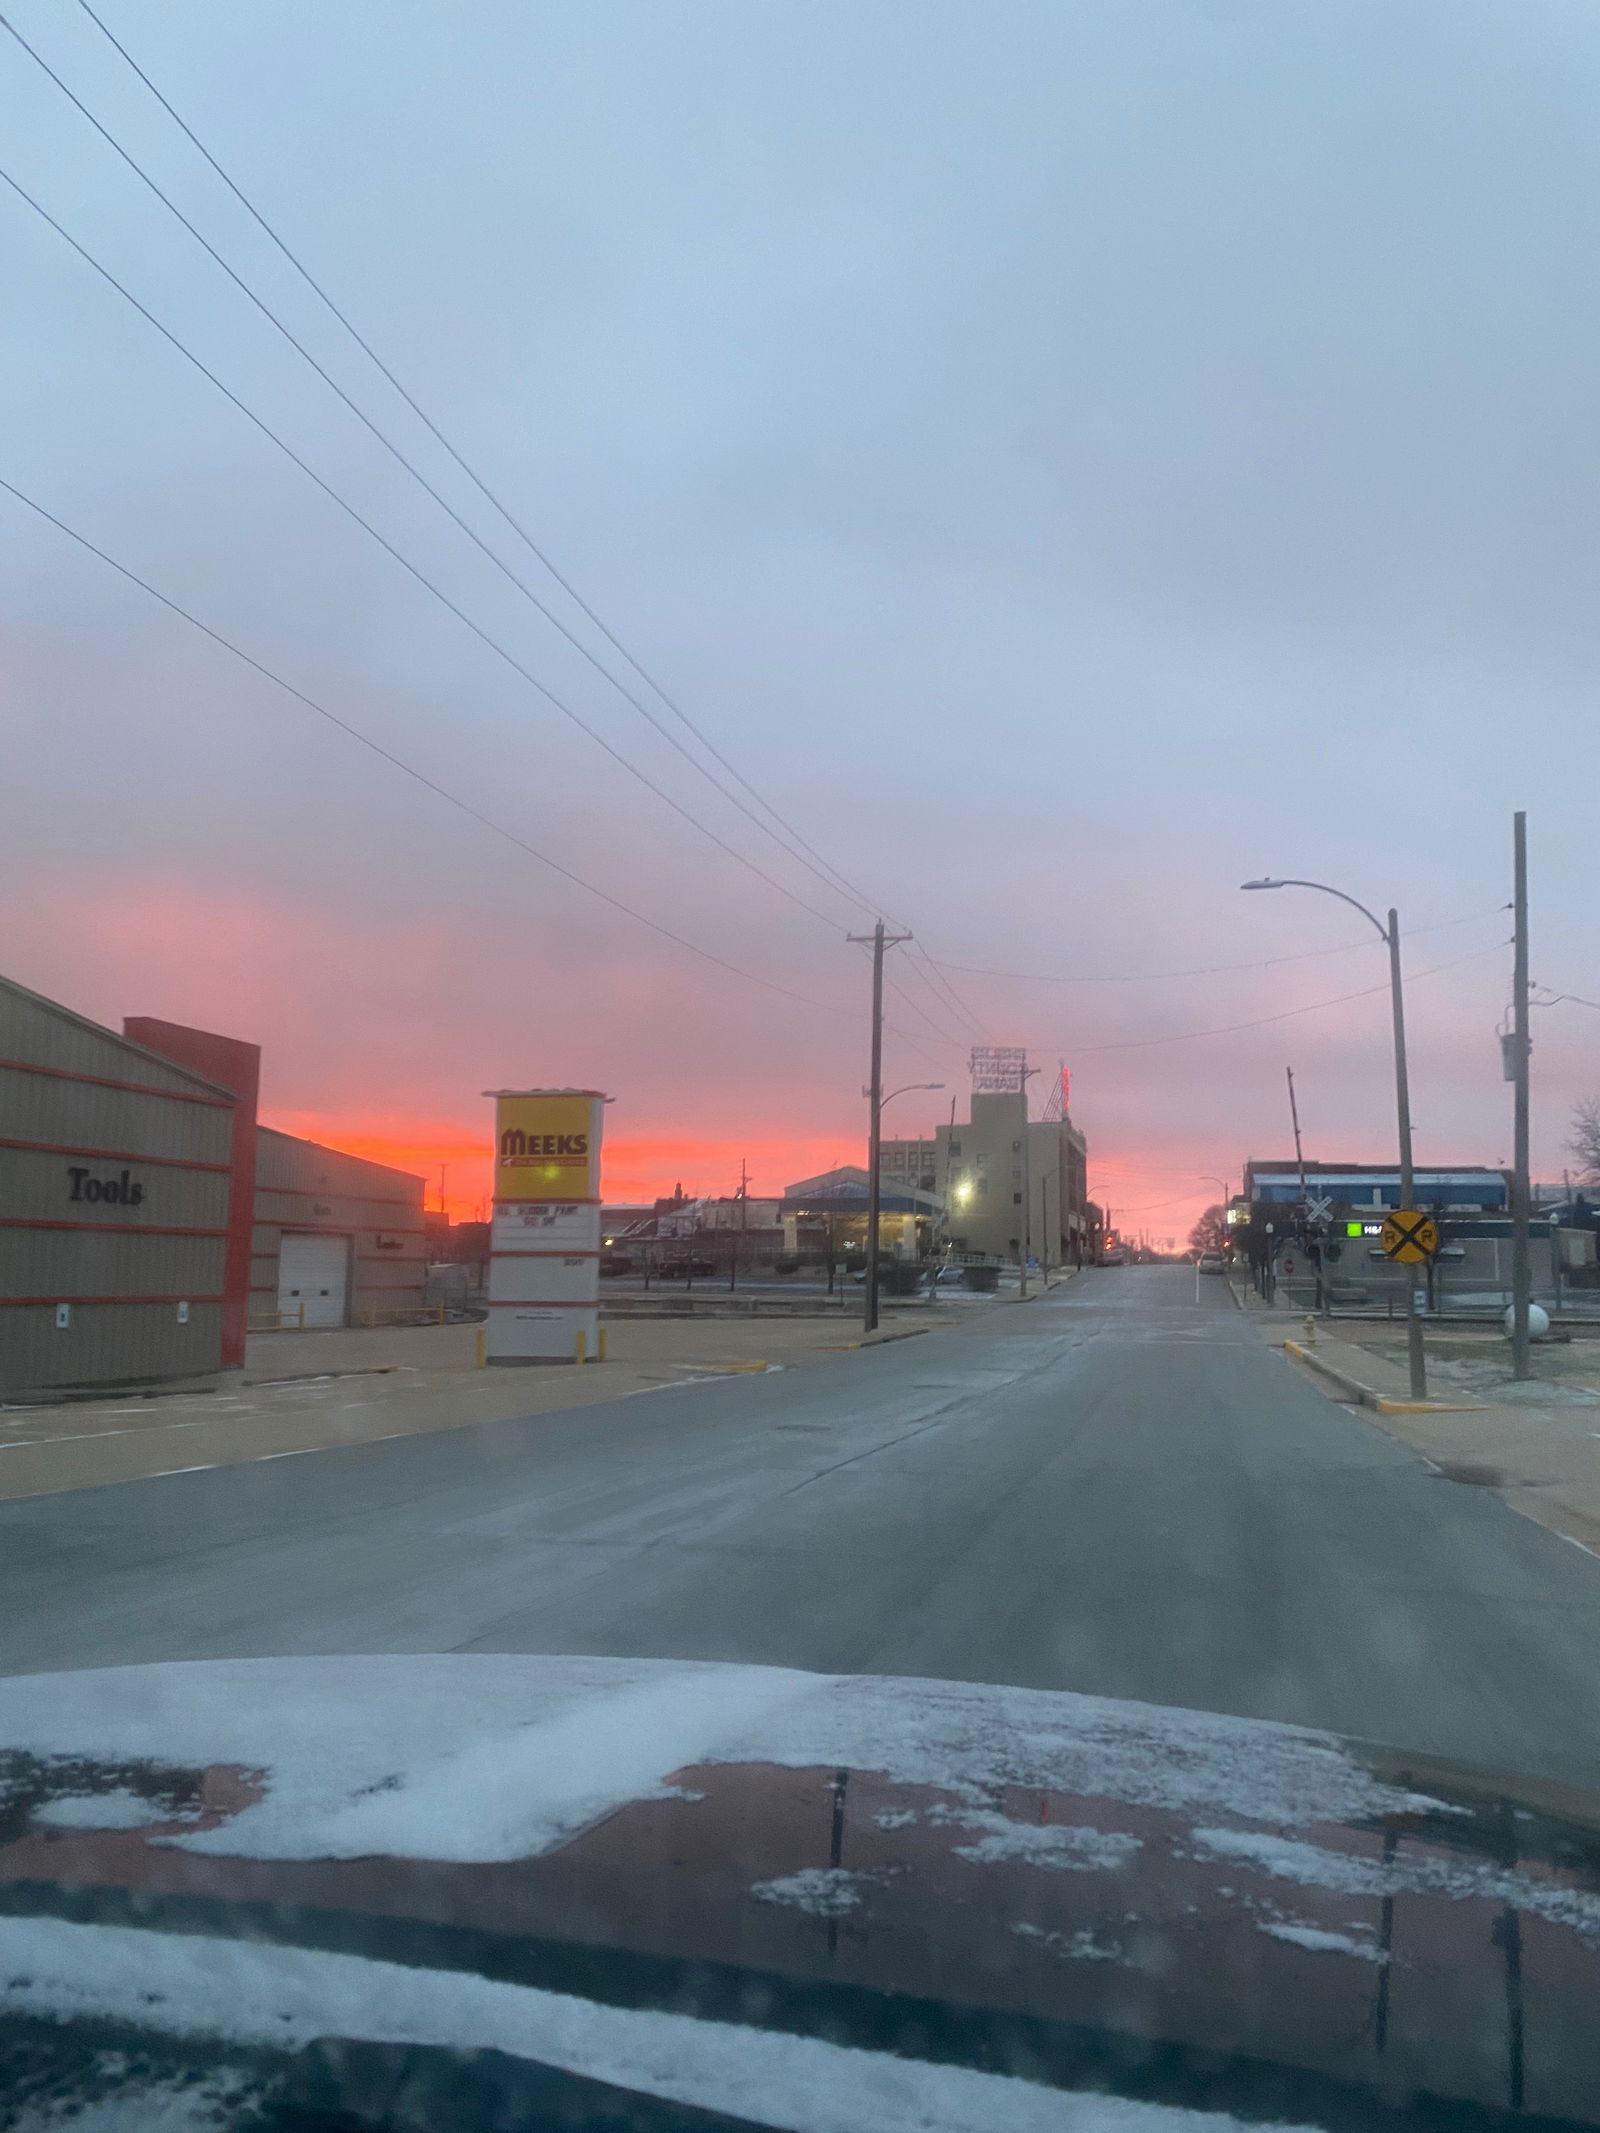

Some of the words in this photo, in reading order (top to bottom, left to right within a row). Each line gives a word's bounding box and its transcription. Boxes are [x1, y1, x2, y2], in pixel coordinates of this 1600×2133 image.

[501, 1128, 588, 1156] MEEKS
[67, 1167, 144, 1206] Tools
[1385, 1231, 1395, 1243] R
[1421, 1229, 1433, 1242] R
